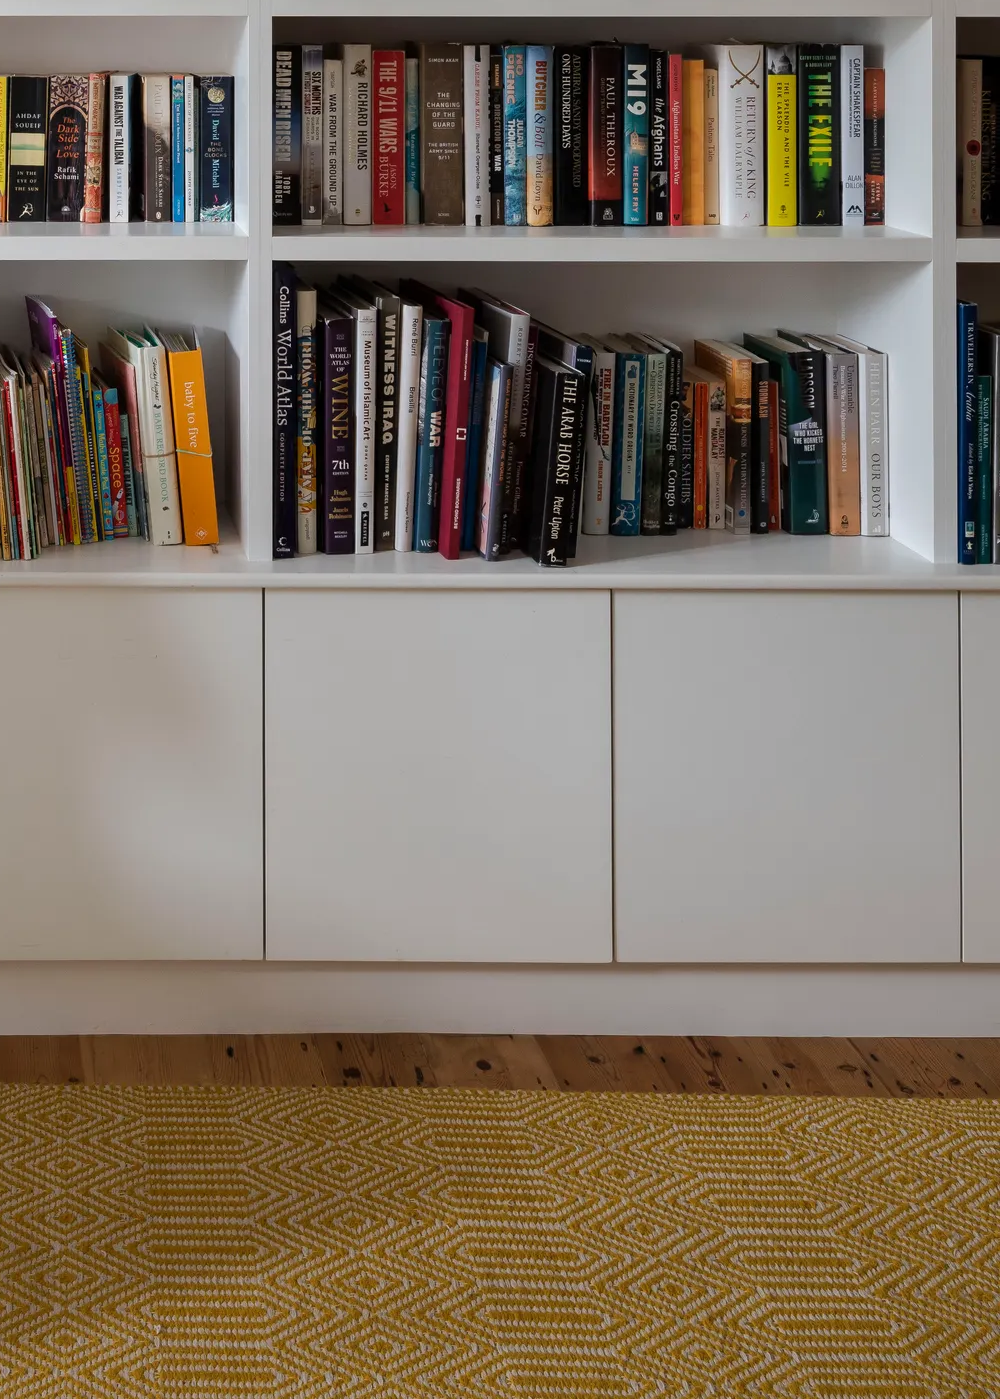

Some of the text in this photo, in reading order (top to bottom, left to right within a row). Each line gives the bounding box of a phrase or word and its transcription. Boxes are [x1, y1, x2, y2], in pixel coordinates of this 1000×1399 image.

[275, 51, 292, 162] DEAD MEN RISEN
[311, 71, 321, 115] SIX MONTHS
[357, 82, 368, 170] RICHARD HOLMES
[378, 60, 397, 153] THE 9/11 WARS
[534, 60, 547, 148] BUTCHER & Bolt
[562, 54, 571, 149] ONE HUNDRED DAYS
[655, 98, 664, 113] the
[808, 71, 832, 167] THE EXILE
[329, 94, 337, 206] WAR FROM THE GROUND UP
[507, 119, 516, 167] THOMPSON
[516, 119, 524, 148] JULIAN
[606, 77, 616, 177] PAUL THEROUX
[651, 115, 665, 166] Afghans
[53, 173, 79, 181] Schami
[57, 166, 77, 174] Rafik
[212, 159, 220, 188] Mitchell
[378, 156, 388, 198] BURKE
[389, 163, 397, 189] JASON
[277, 286, 292, 426] Collins World Atlas
[382, 315, 396, 445] WITNESS IRAQ
[183, 381, 199, 448] baby to five
[330, 373, 349, 440] WINE
[363, 340, 373, 441] Museum of Islamic Art
[601, 368, 612, 446] FIRE IN BABYLON
[428, 410, 442, 448] WAR
[555, 378, 578, 485] THE ARAB HORSE
[667, 400, 681, 451] Crossing
[331, 460, 350, 470] 7th
[665, 469, 679, 507] Congo
